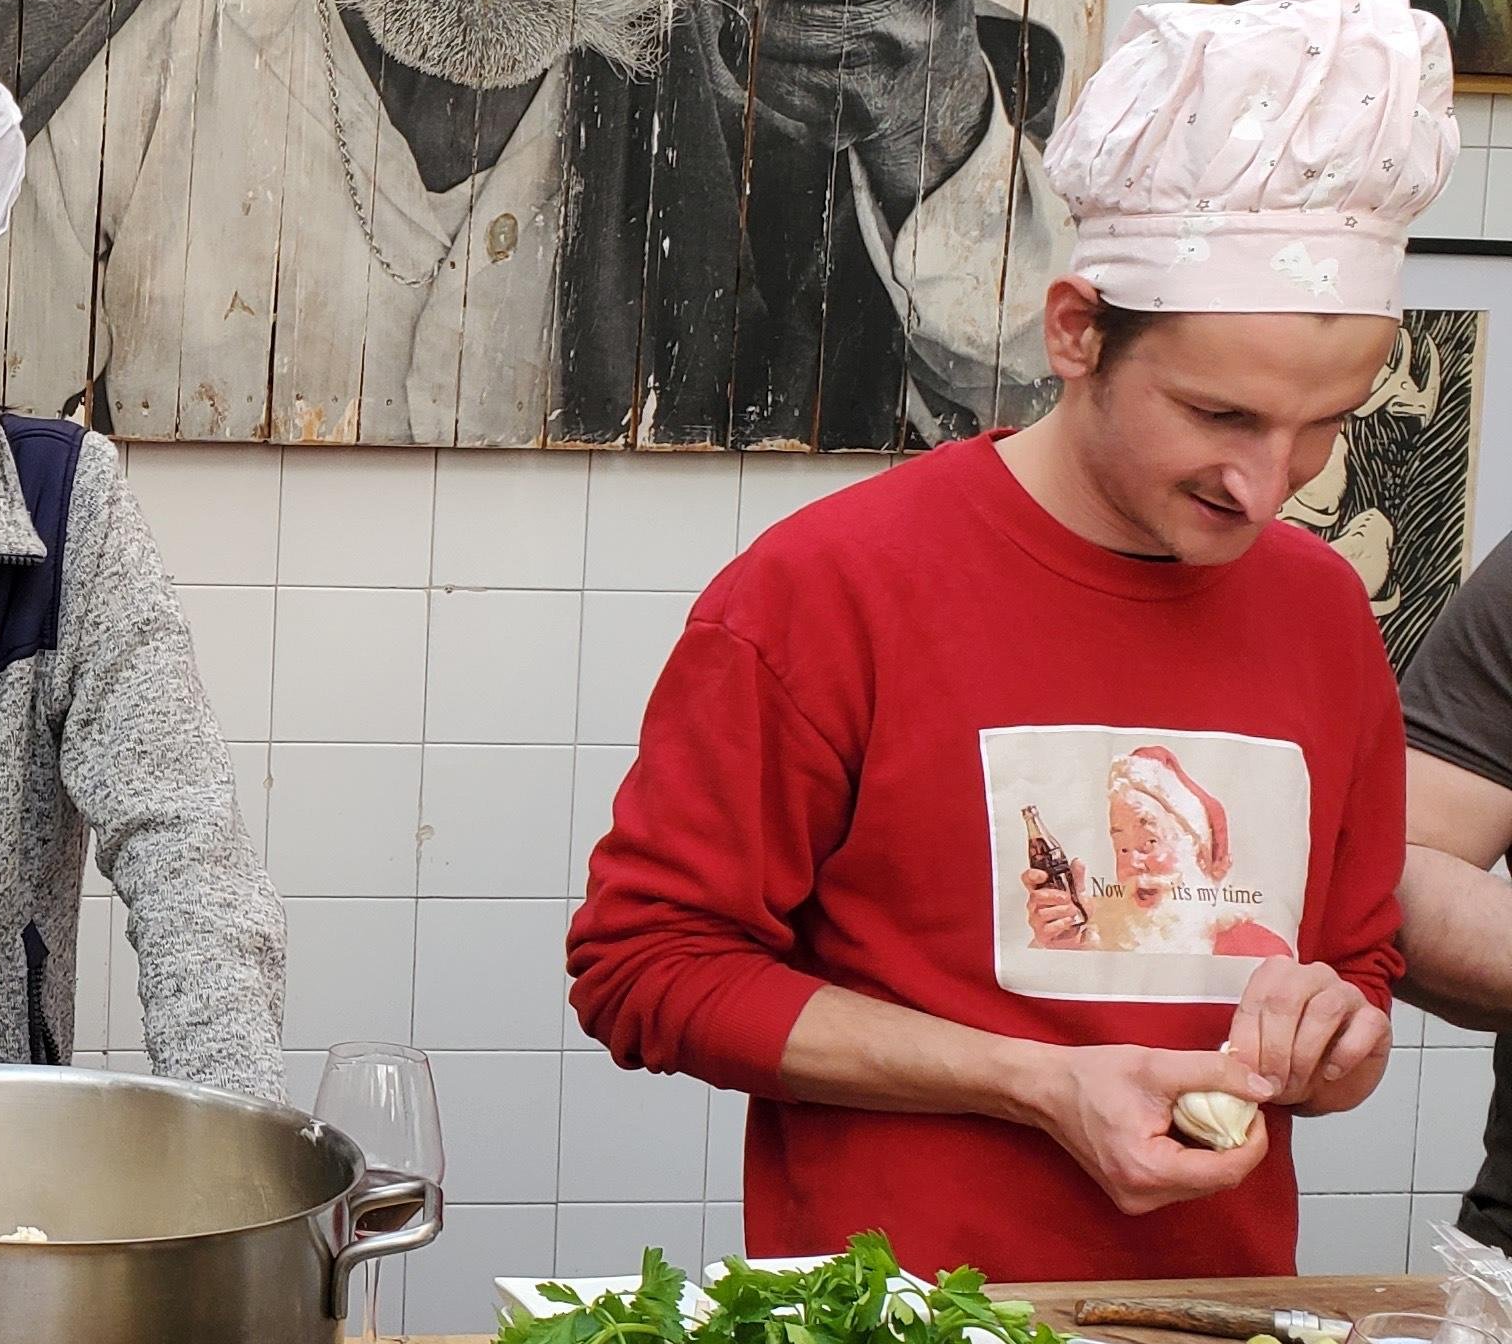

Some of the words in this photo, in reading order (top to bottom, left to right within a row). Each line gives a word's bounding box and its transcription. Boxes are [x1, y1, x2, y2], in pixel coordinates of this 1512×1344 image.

[1091, 877, 1126, 898] Now
[1171, 881, 1193, 902] it's
[1197, 886, 1218, 907] my
[1221, 885, 1264, 905] time
